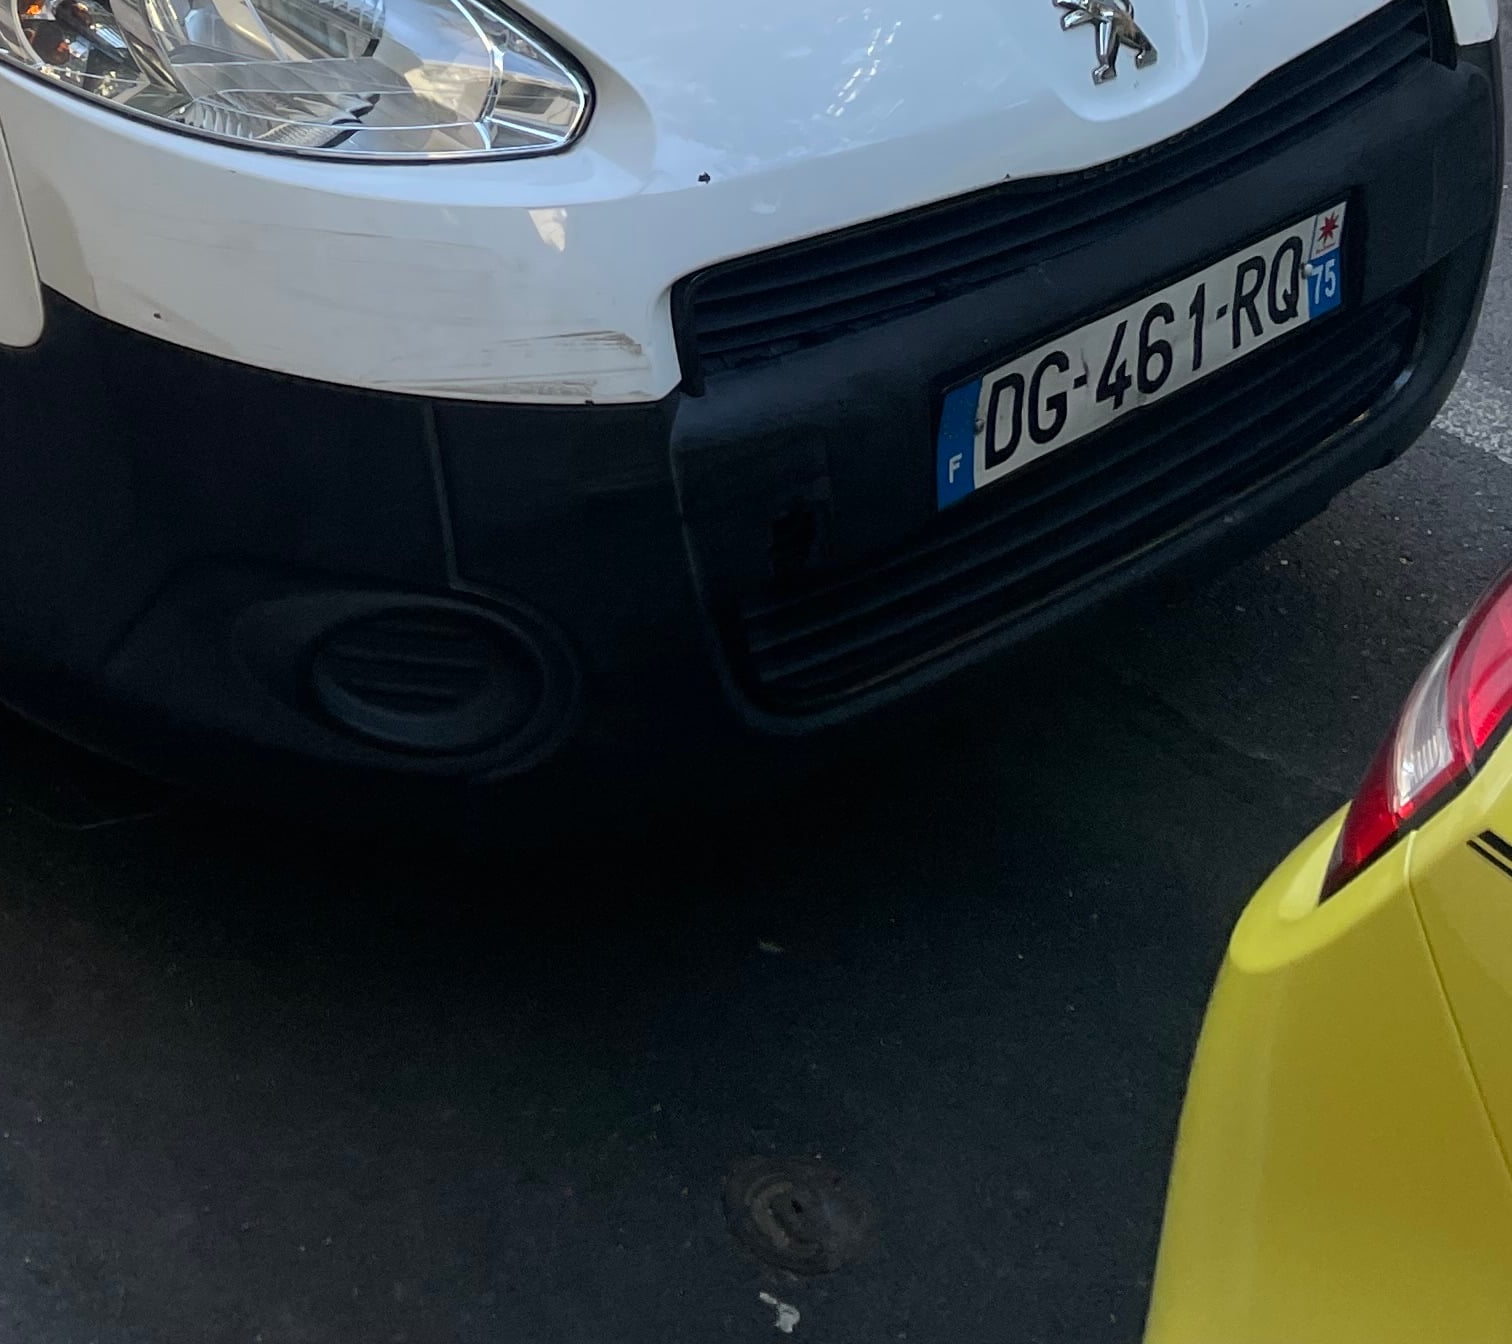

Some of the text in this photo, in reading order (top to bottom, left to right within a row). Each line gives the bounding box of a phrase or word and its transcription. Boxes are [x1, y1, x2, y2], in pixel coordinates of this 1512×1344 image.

[1311, 258, 1337, 305] 75
[985, 236, 1303, 471] DG-461-RQ
[948, 453, 963, 484] F
